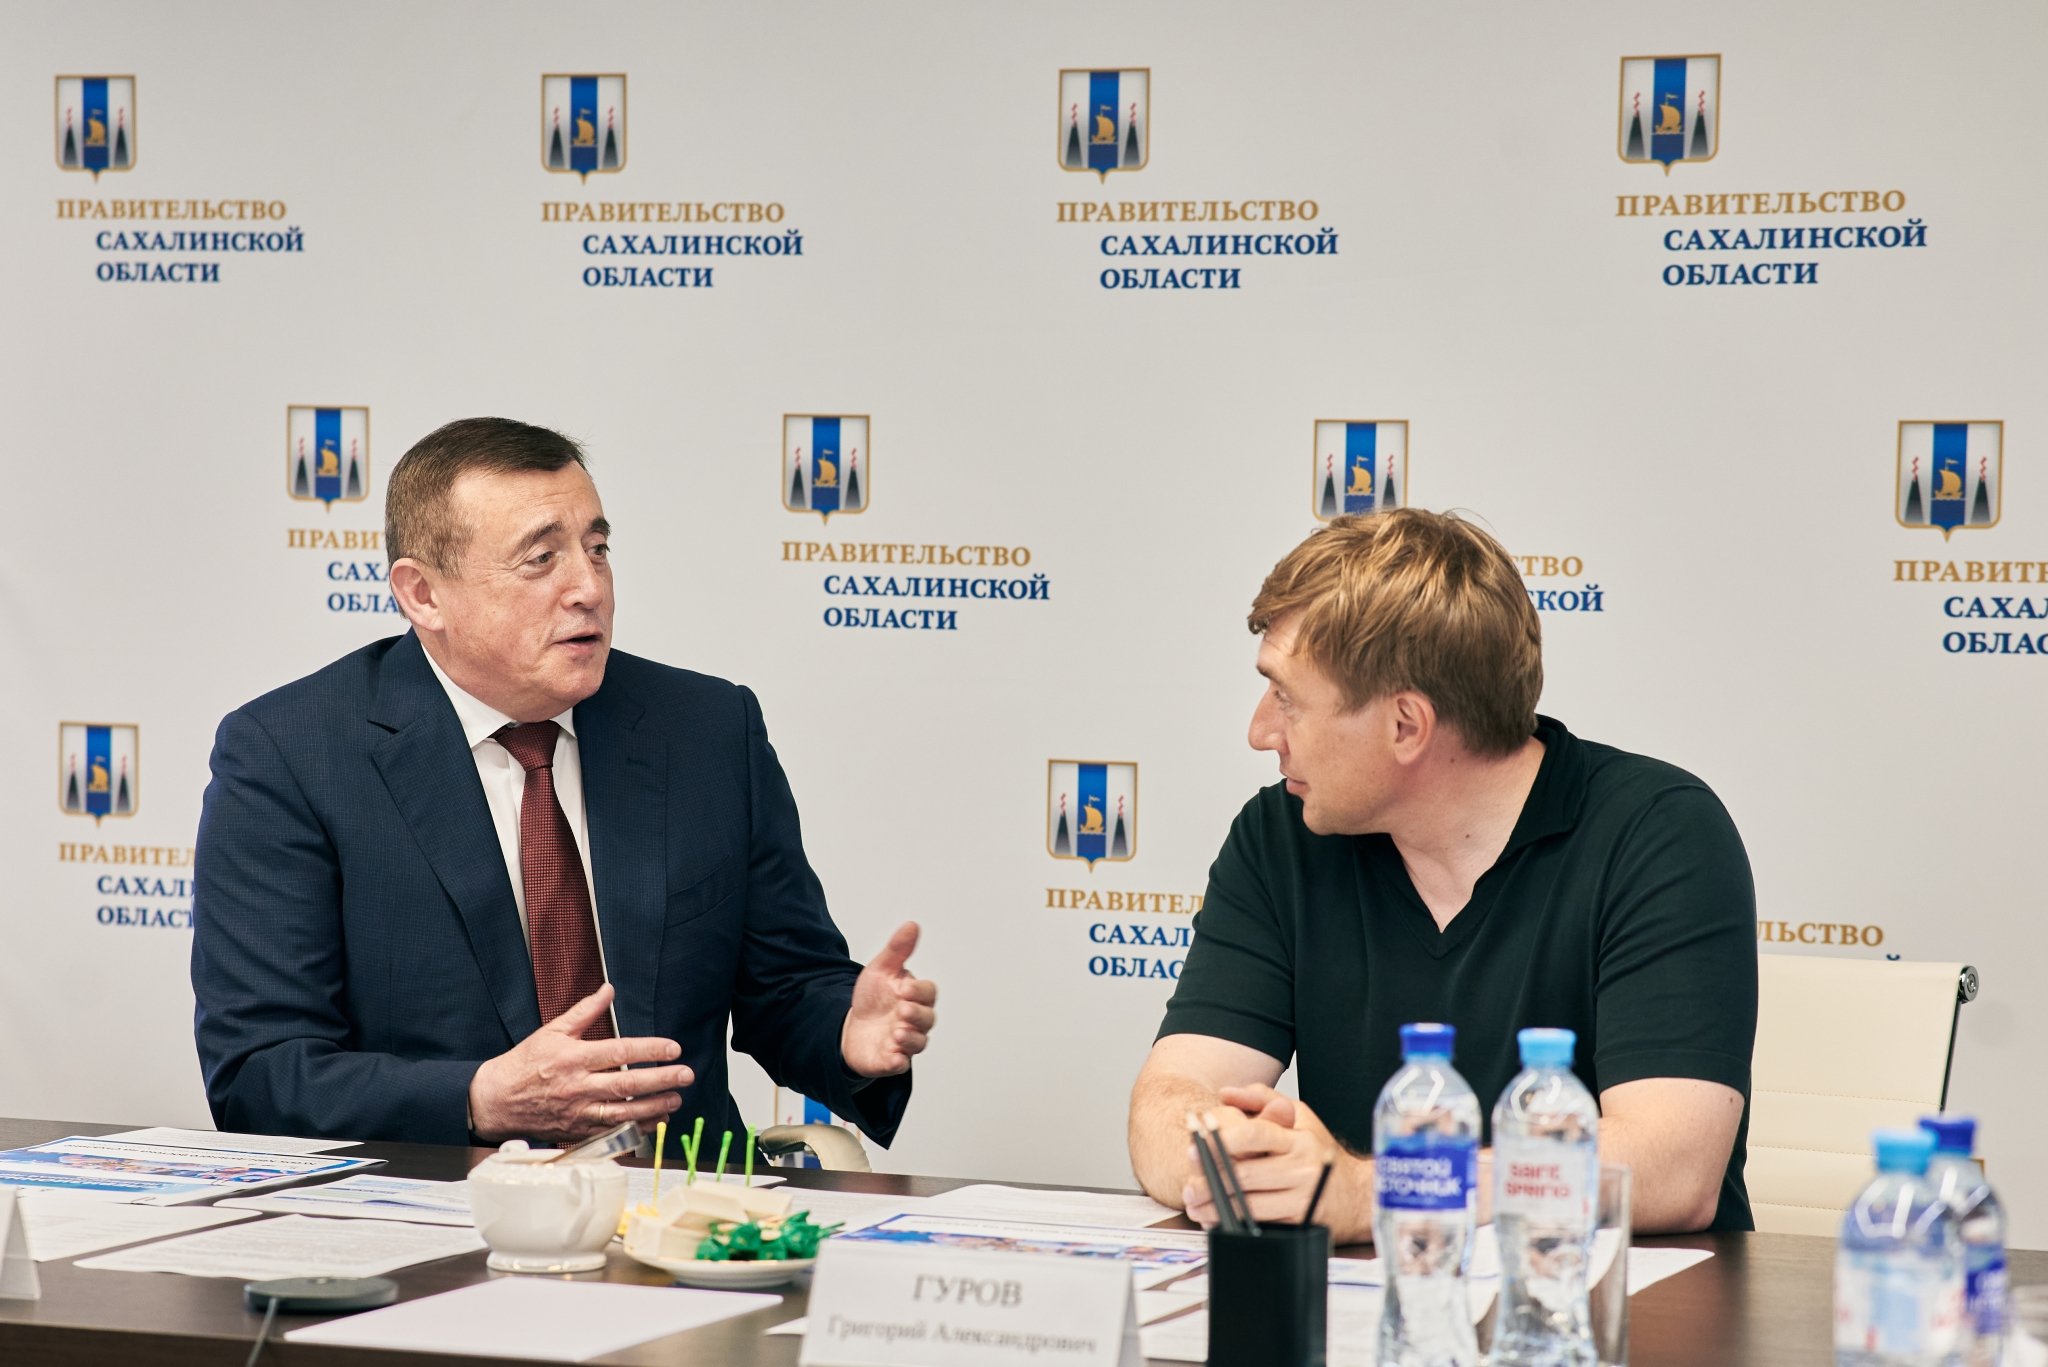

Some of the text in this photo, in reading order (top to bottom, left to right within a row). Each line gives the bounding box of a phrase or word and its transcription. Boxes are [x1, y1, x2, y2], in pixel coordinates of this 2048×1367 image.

[56, 199, 287, 221] ПРАВИТЕЛЬСТВО
[542, 201, 785, 223] ПРАВИТЕЛЬСТВО
[1057, 200, 1319, 223] ПРАВИТЕЛЬСТВО
[1616, 189, 1906, 217] ПРАВИТЕЛЬСТВО
[96, 226, 304, 253] САХАЛИНСКОЙ
[582, 228, 804, 256] САХАЛИНСКОЙ
[1100, 227, 1339, 256] САХАЛИНСКОЙ
[1663, 218, 1928, 252] САХАЛИНСКОЙ
[96, 262, 220, 284] ОБЛАСТИ
[582, 266, 714, 288] ОБЛАСТИ
[1099, 268, 1242, 289] ОБЛАСТИ
[1662, 262, 1819, 287] ОБЛАСТИ
[287, 528, 386, 549] ПРАВИ
[782, 541, 1031, 567] ПРАВИТЕЛЬСТВО
[1512, 555, 1584, 577] ТВО
[823, 573, 1051, 601] САХАЛИНСКОЙ
[1527, 584, 1604, 612] КОЙ
[823, 607, 958, 631] ОБЛАСТИ
[97, 875, 195, 897] САХАЛ
[1088, 923, 1191, 947] САХАЛ
[913, 1275, 1024, 1307] ГУРОВ
[828, 1315, 1097, 1355] Григорий Александрович
